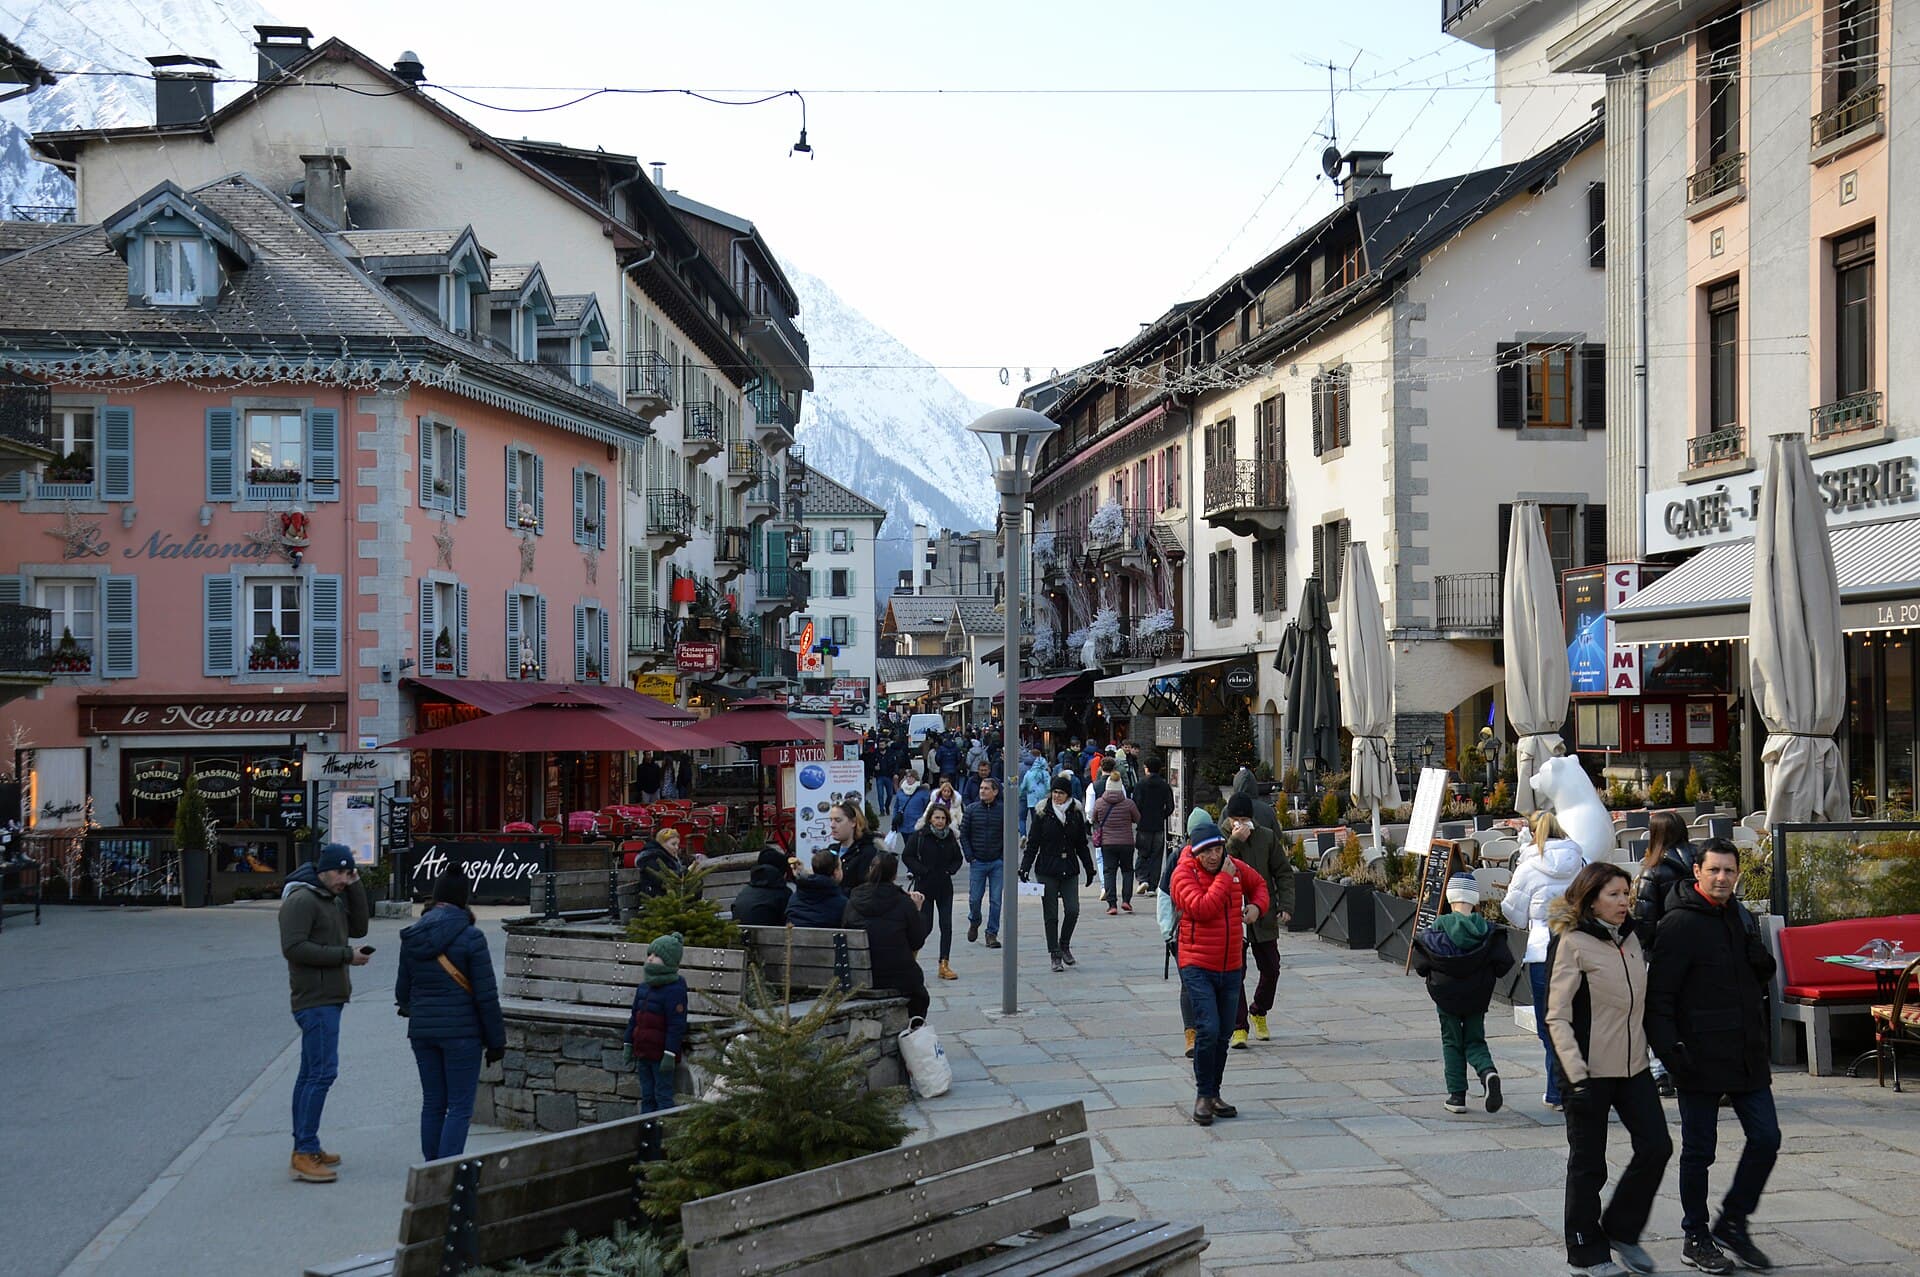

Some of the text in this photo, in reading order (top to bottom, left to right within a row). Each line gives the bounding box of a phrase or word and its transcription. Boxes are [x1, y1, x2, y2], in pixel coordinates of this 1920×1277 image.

[124, 530, 273, 558] Nationa
[1878, 604, 1920, 623] LA PO
[1613, 570, 1634, 688] CIMA
[836, 679, 868, 688] Station
[121, 704, 307, 729] le National
[780, 749, 790, 763] LE
[136, 770, 179, 781] FONDUES
[322, 754, 378, 778] Atmosphère
[131, 787, 184, 801] RACLETTES
